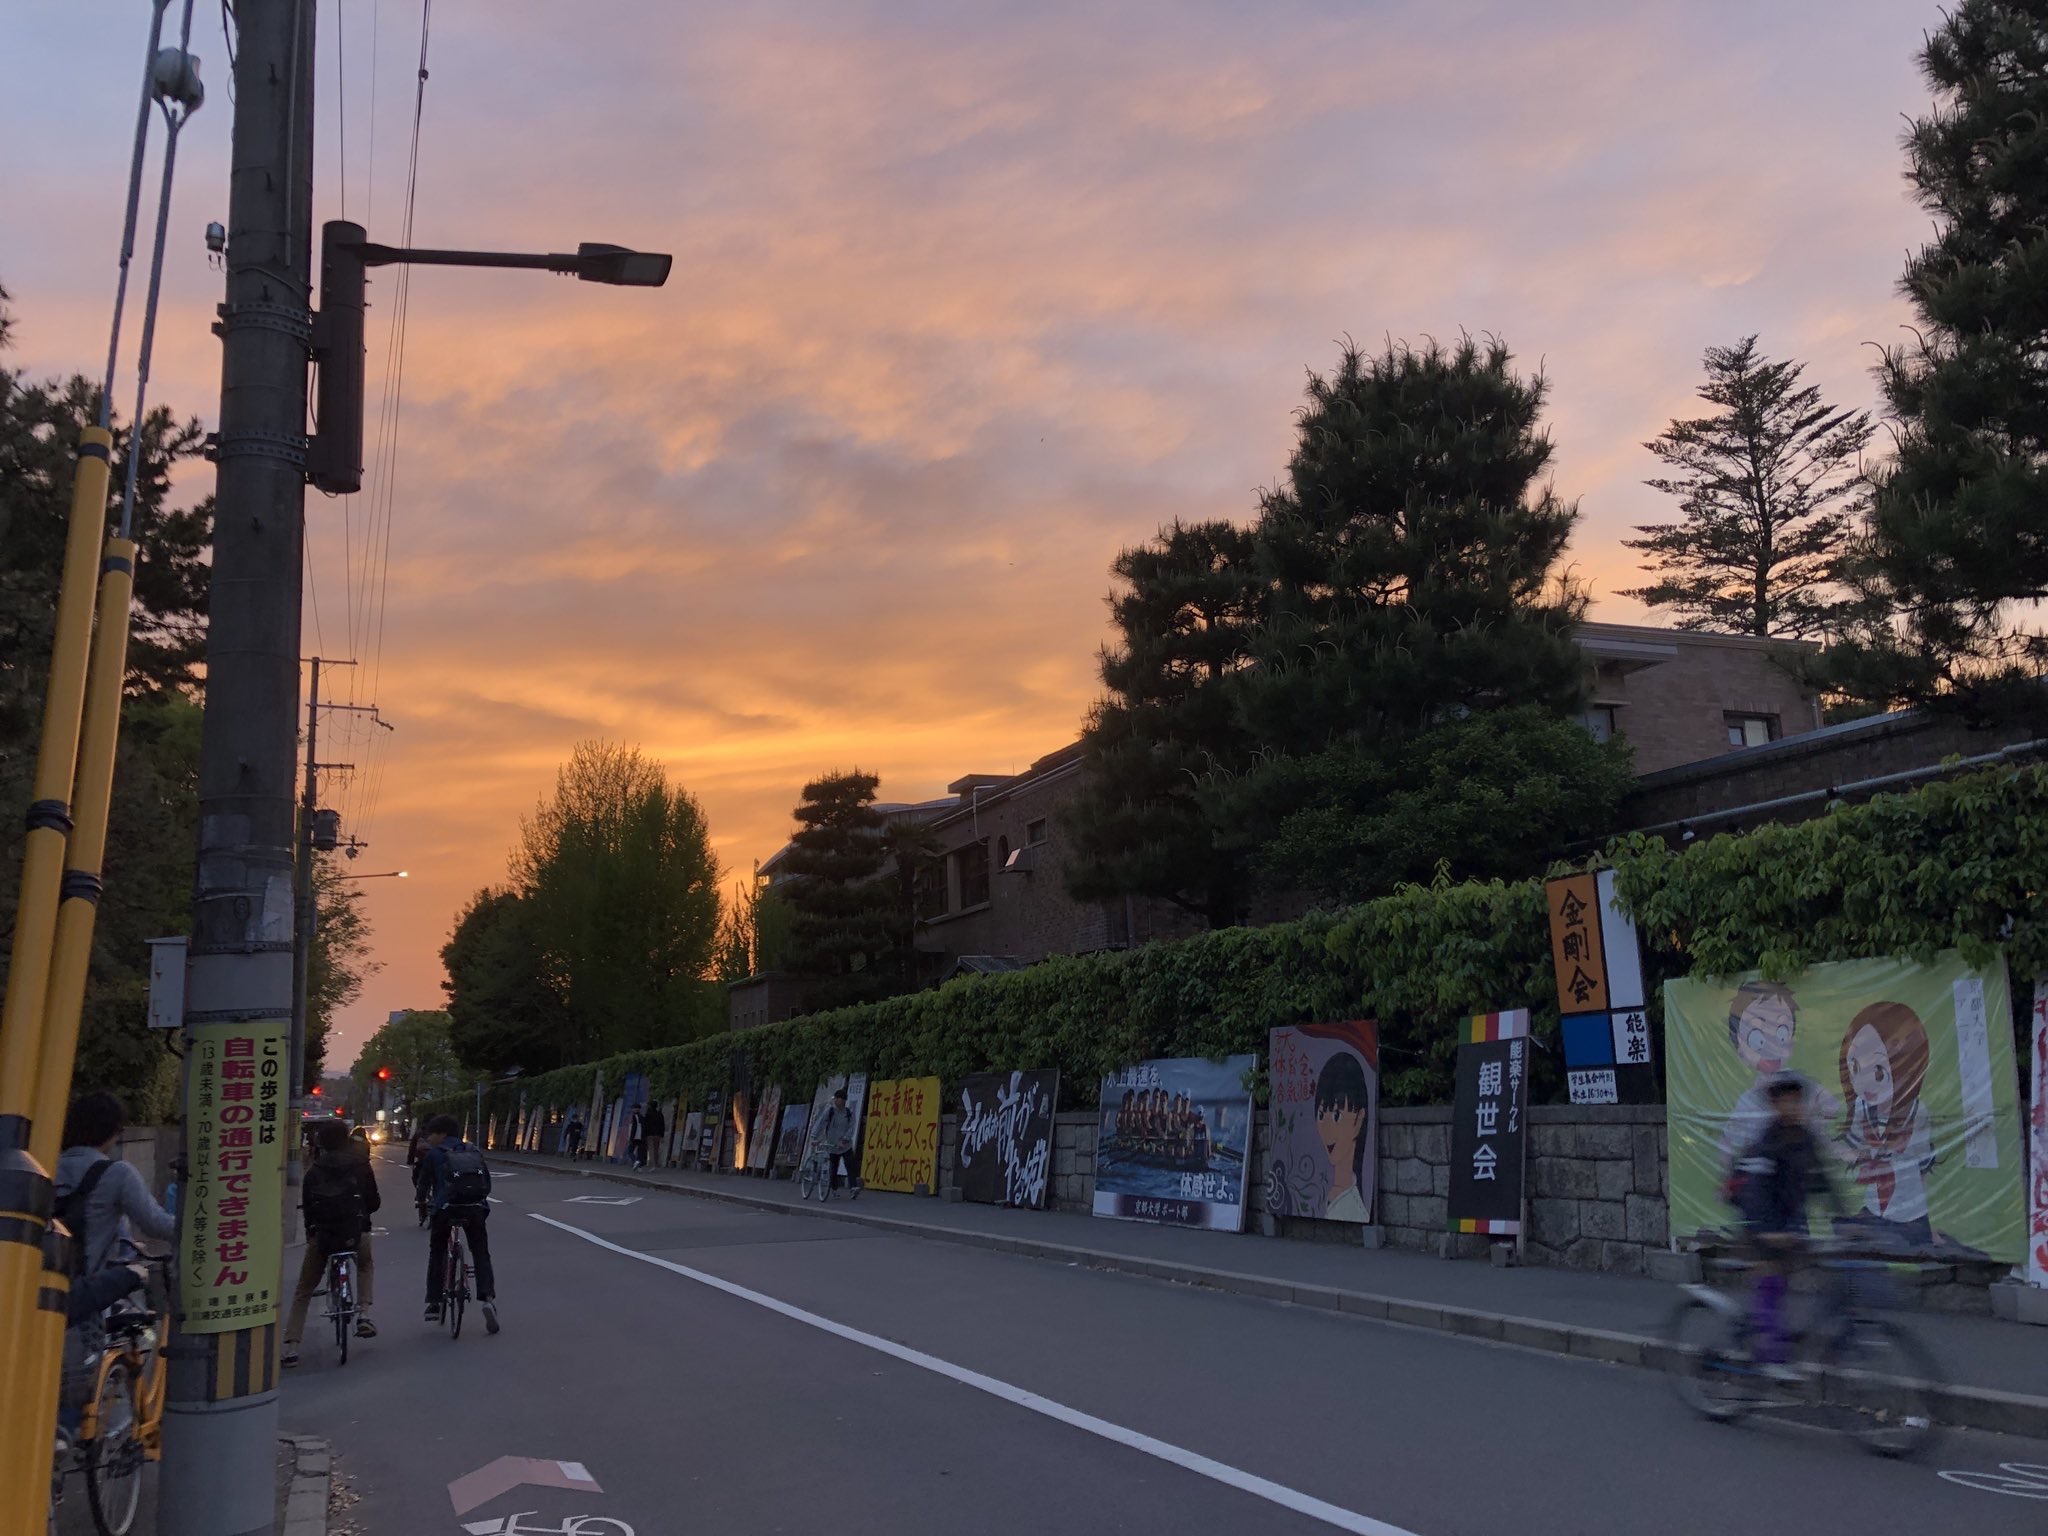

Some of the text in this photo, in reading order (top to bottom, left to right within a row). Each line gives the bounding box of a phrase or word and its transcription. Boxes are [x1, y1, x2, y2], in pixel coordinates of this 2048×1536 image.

[1559, 888, 1598, 1005] 金剛会
[1626, 1013, 1647, 1062] 能楽
[258, 1037, 279, 1145] この歩道は
[869, 1083, 924, 1118] 立て看板を
[1507, 1040, 1523, 1134] 能楽サークル
[867, 1121, 937, 1151] どんどんつくって
[1472, 1061, 1502, 1181] 観世会
[213, 1036, 256, 1288] 自転車の通行できません
[864, 1154, 932, 1186] どんどん立てよう
[1134, 1200, 1190, 1221] 京都大学ボート部
[1179, 1172, 1235, 1202] 体感せよ。
